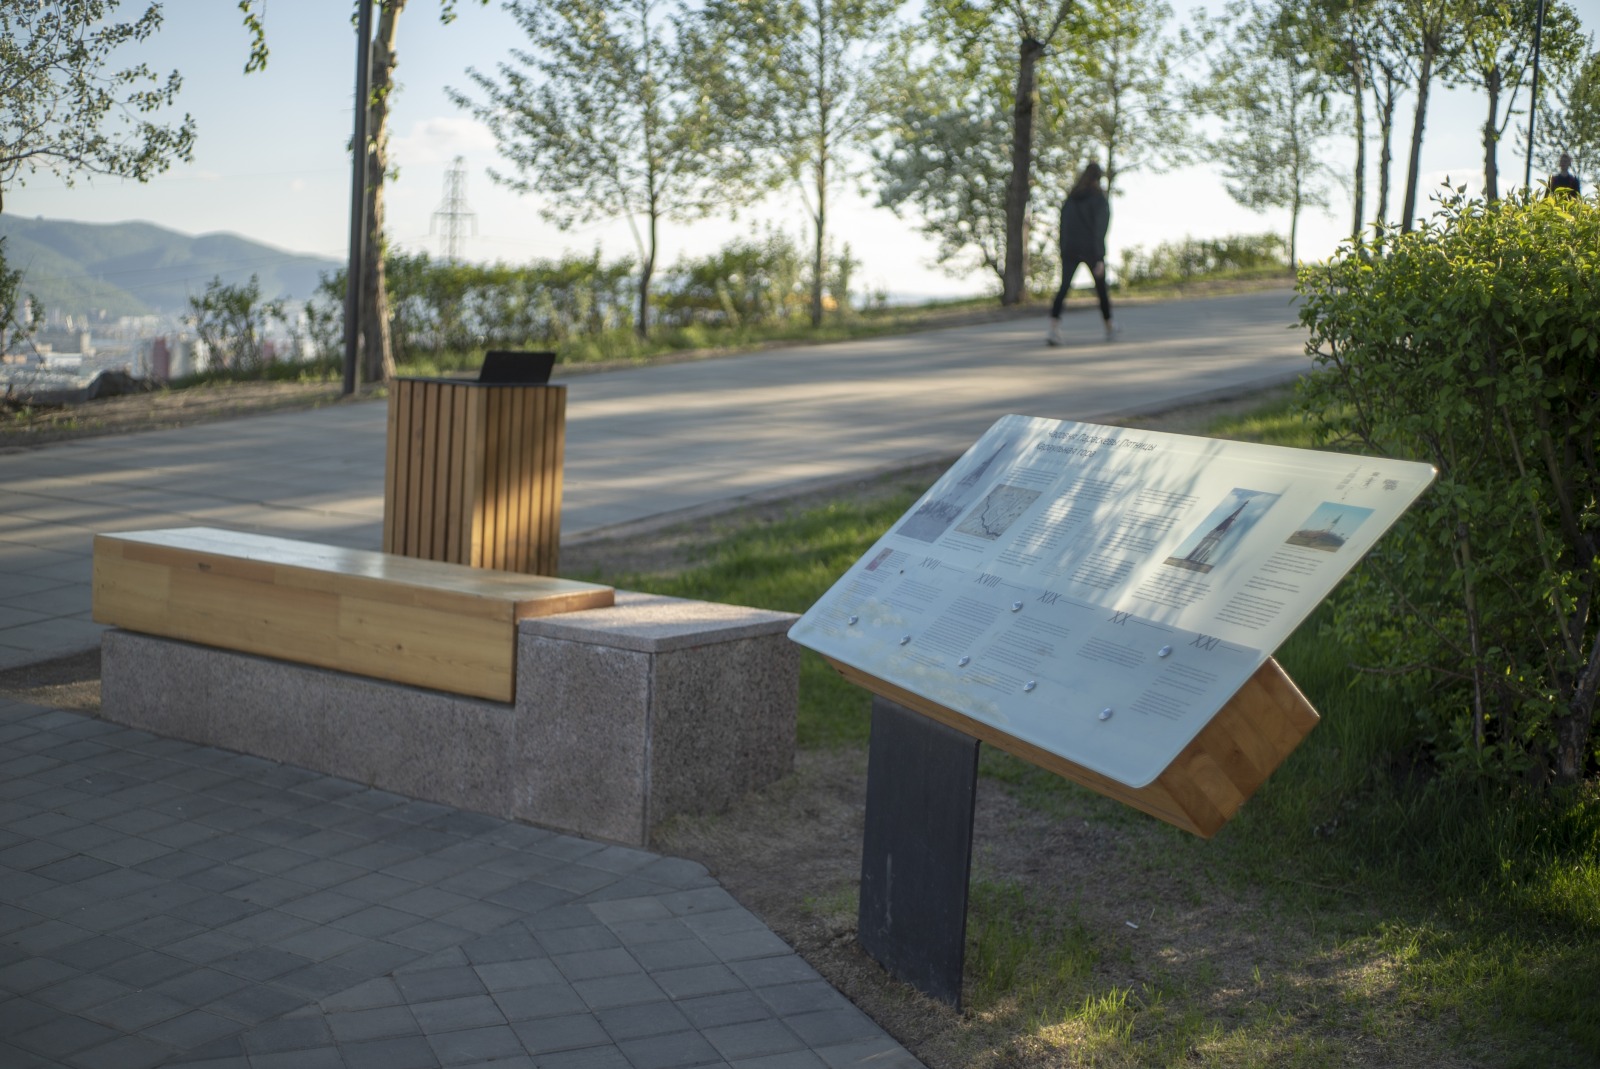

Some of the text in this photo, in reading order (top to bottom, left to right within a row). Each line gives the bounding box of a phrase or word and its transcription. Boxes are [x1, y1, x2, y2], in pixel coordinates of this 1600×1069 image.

[1120, 439, 1157, 451] Пятницы
[919, 556, 942, 570] XVII
[974, 572, 1002, 588] XVIII
[1037, 589, 1063, 606] XIX
[1107, 610, 1133, 626] XX
[1189, 633, 1221, 651] XXI
